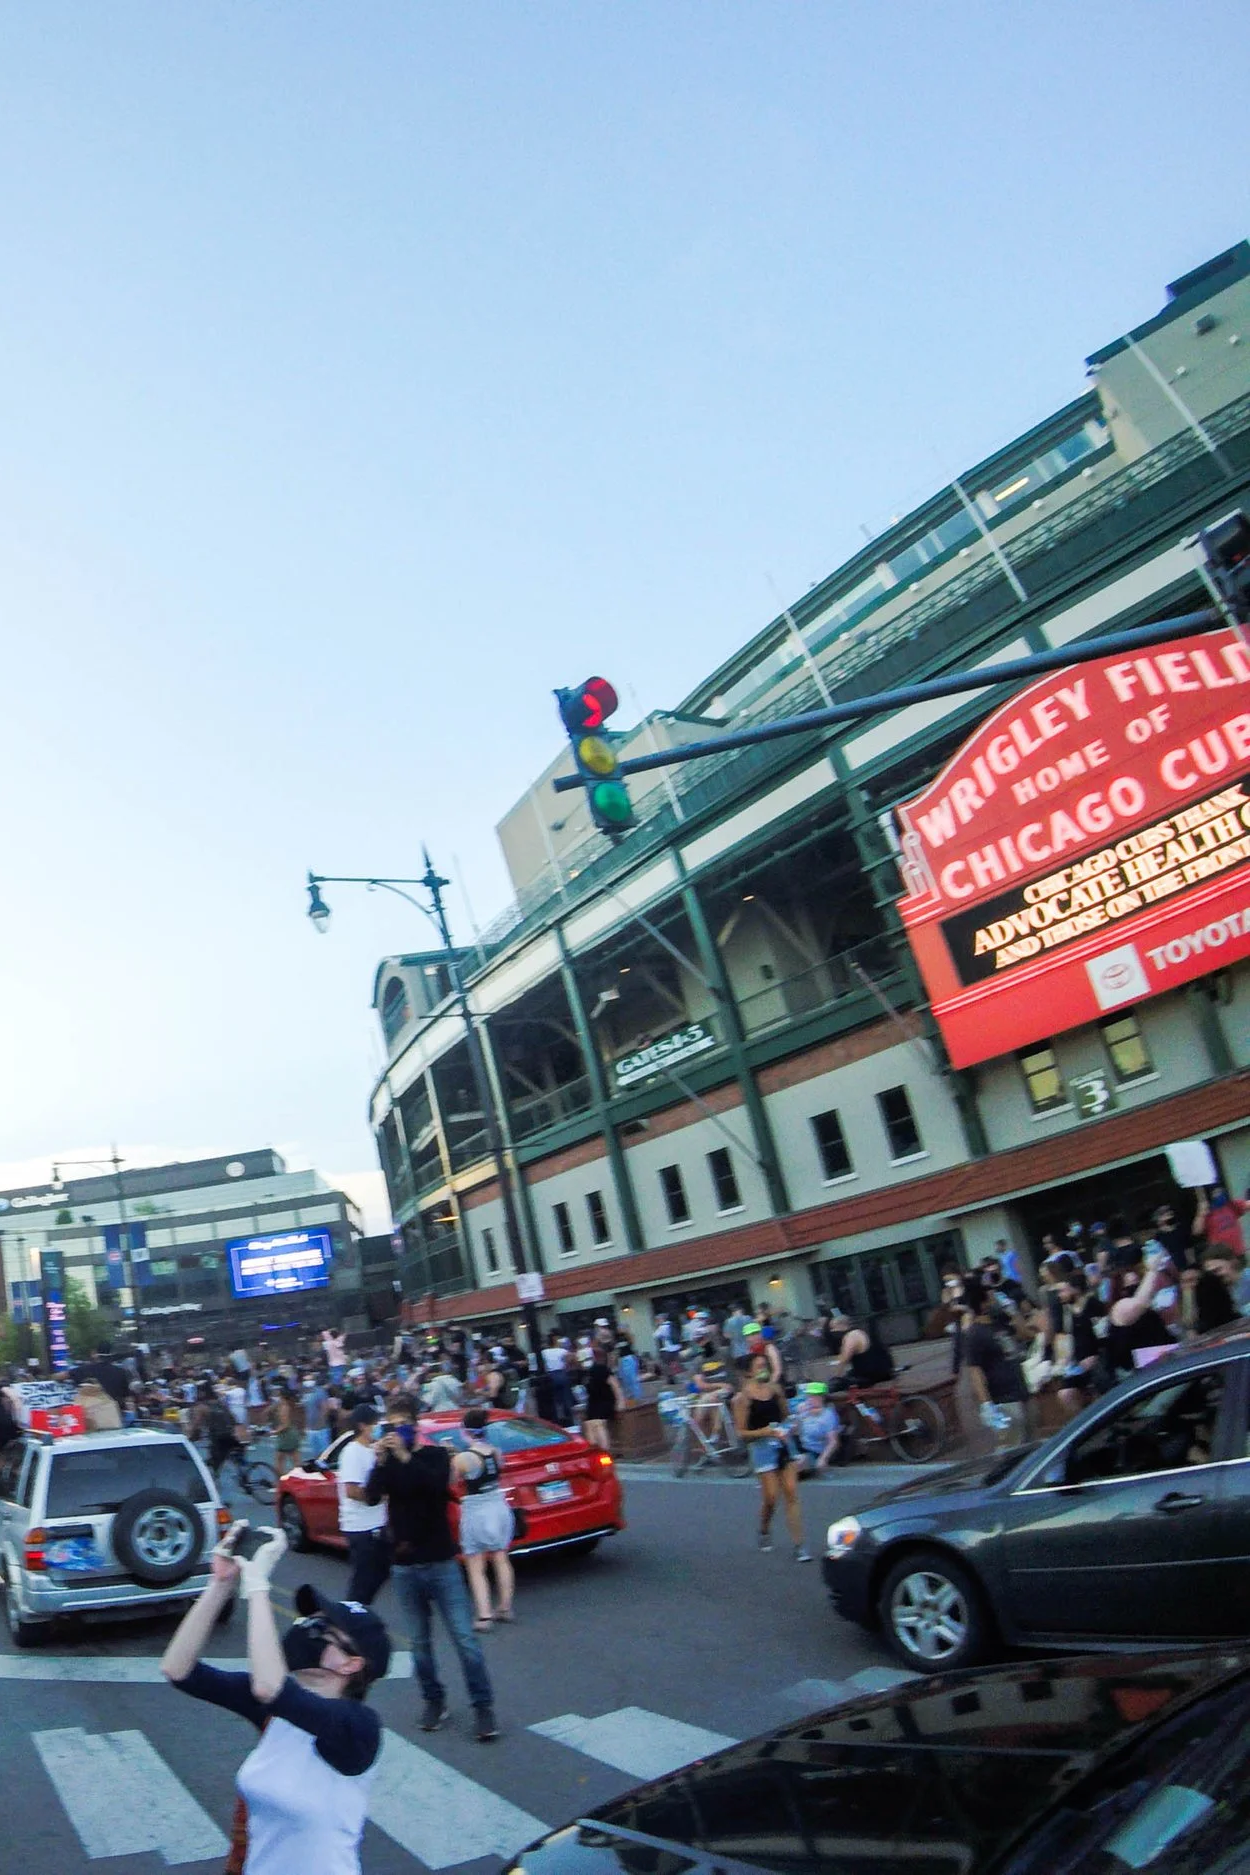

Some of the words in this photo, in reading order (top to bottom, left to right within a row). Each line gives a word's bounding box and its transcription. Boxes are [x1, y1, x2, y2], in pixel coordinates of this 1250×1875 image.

[917, 679, 1091, 848] WRIGLEY
[1010, 739, 1110, 806] HOME
[1125, 703, 1171, 744] OF
[940, 776, 1146, 899] CHICAGO
[974, 868, 1126, 956] ADVOCATE
[1120, 810, 1245, 887] HEALTH
[1023, 848, 1119, 904] CHICAGO
[1115, 821, 1175, 860] CUBS
[1169, 783, 1249, 834] THANK
[995, 936, 1042, 969] AND
[1036, 905, 1109, 948] THOSE
[1105, 890, 1142, 918] ON
[1139, 869, 1187, 903] THE
[1077, 1080, 1109, 1110] 3
